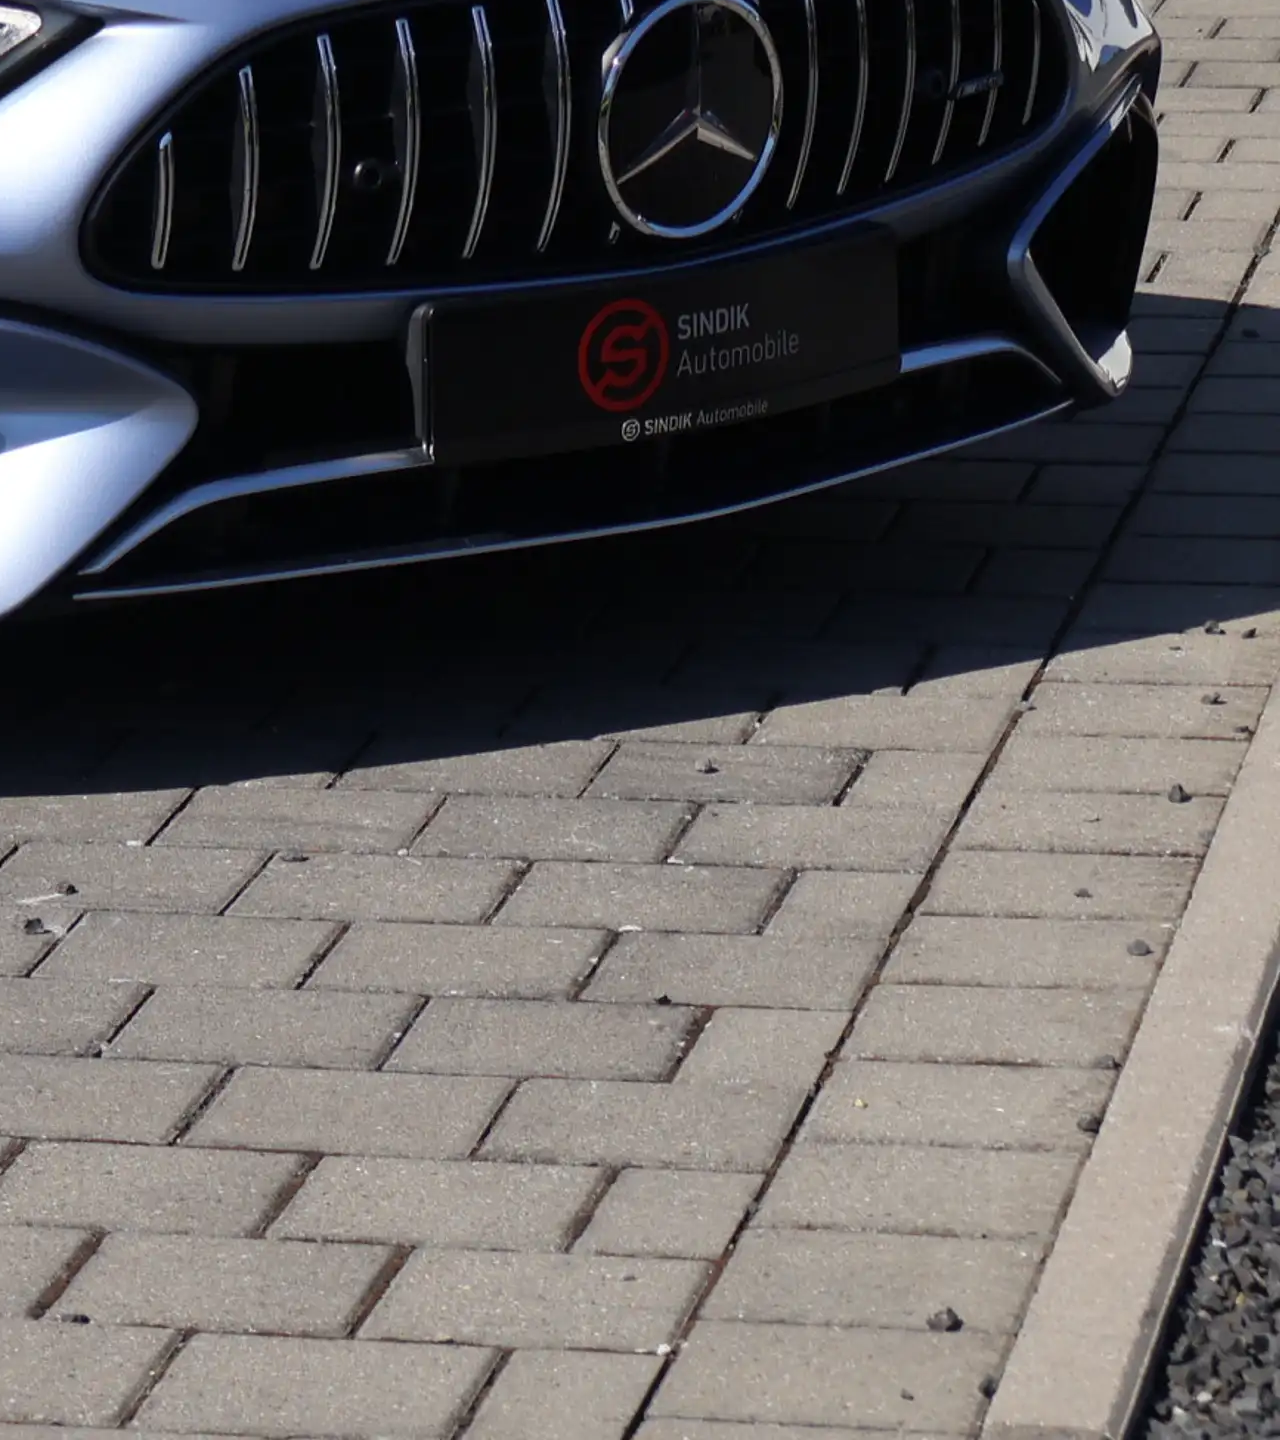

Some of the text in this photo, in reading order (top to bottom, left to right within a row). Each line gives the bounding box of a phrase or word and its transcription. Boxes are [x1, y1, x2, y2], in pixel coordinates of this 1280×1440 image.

[677, 302, 749, 341] SINDIK
[676, 328, 800, 378] Automobile
[644, 399, 768, 436] SINDIK Automobile
